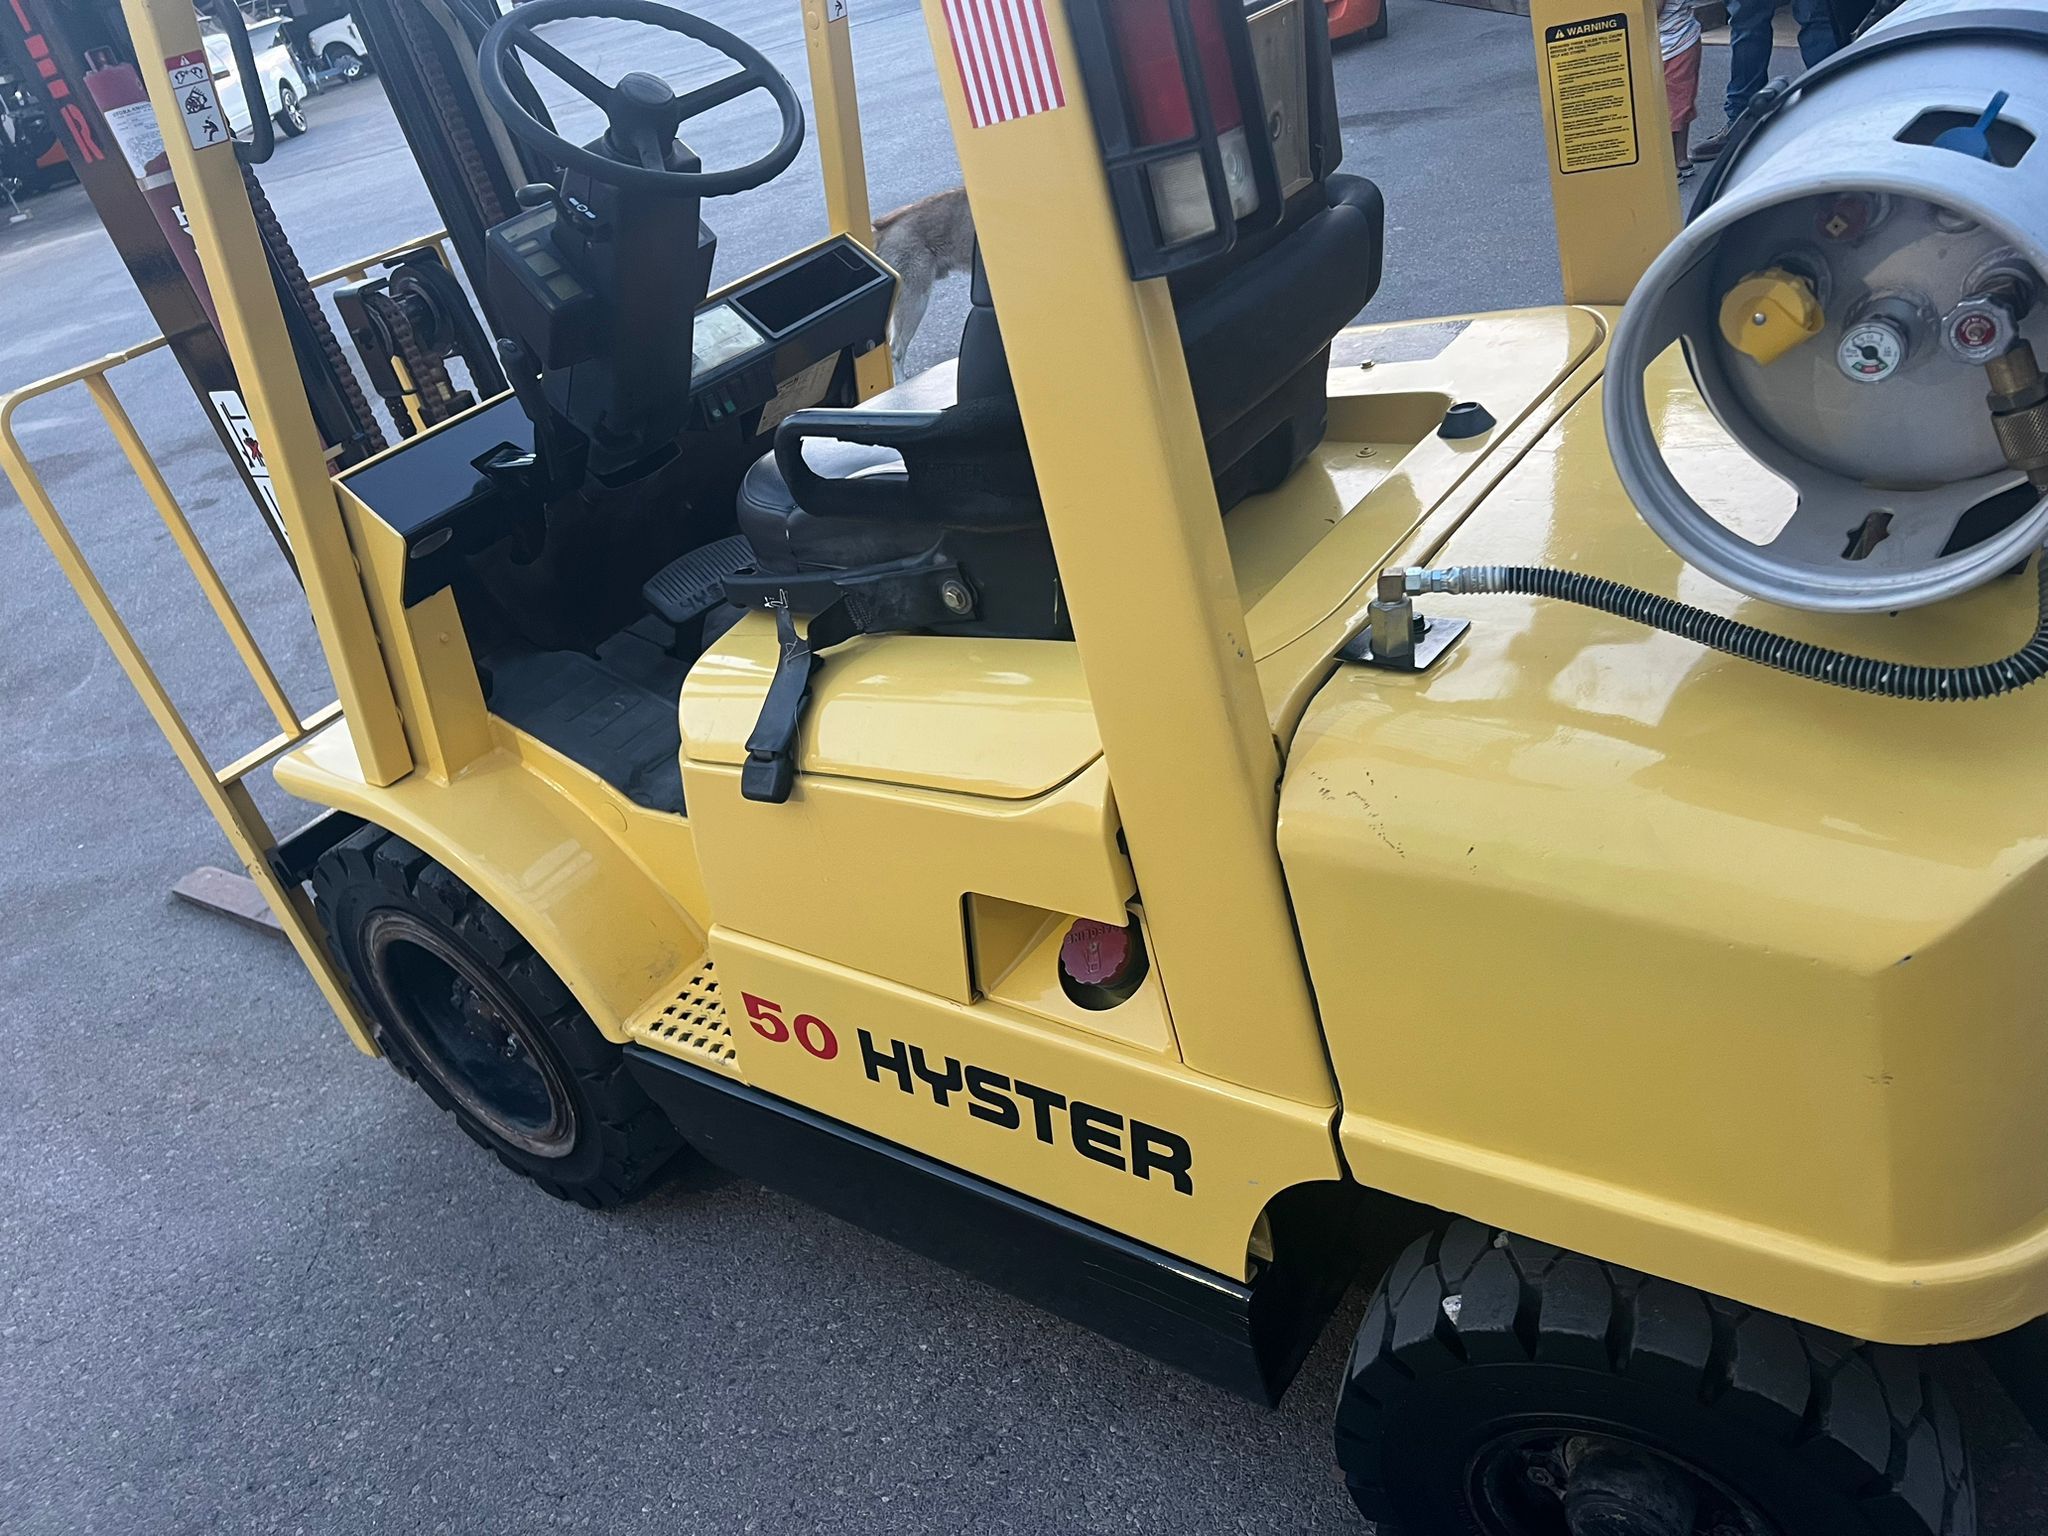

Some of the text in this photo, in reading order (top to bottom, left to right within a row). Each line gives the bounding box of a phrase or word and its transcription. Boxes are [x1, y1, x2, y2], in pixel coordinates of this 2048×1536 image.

[1566, 19, 1617, 36] WARNING
[740, 991, 1194, 1196] 50 HYSTER
